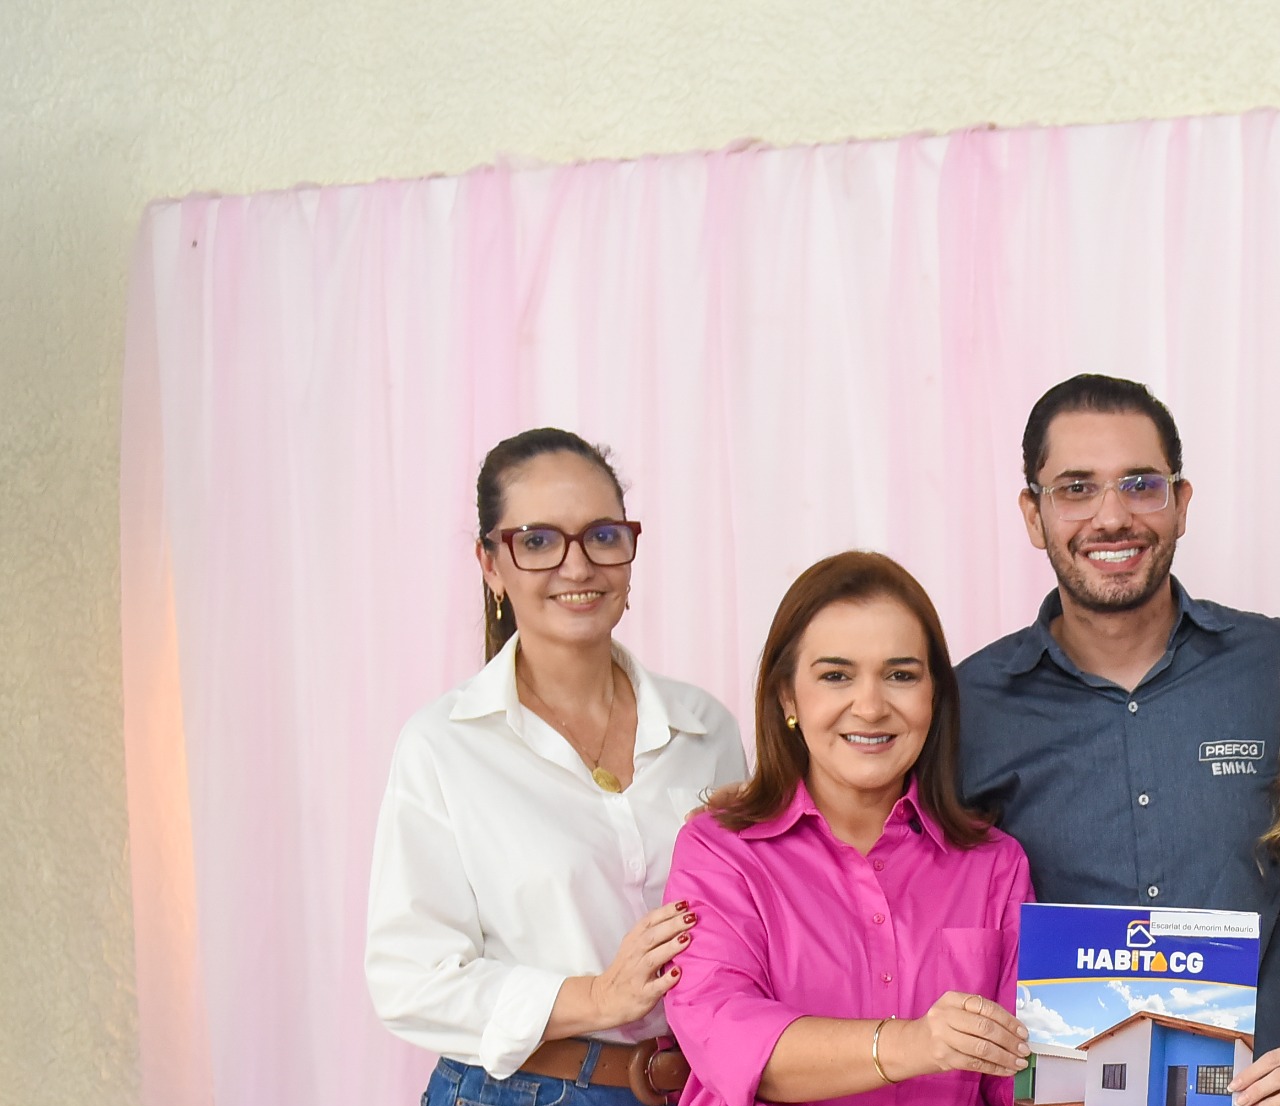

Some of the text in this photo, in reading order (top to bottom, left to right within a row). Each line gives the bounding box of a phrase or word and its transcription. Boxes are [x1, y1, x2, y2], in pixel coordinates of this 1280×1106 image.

[1205, 743, 1258, 757] PREFCG
[1211, 760, 1257, 776] EMHA
[1182, 923, 1192, 931] de
[1194, 923, 1222, 932] Amorim
